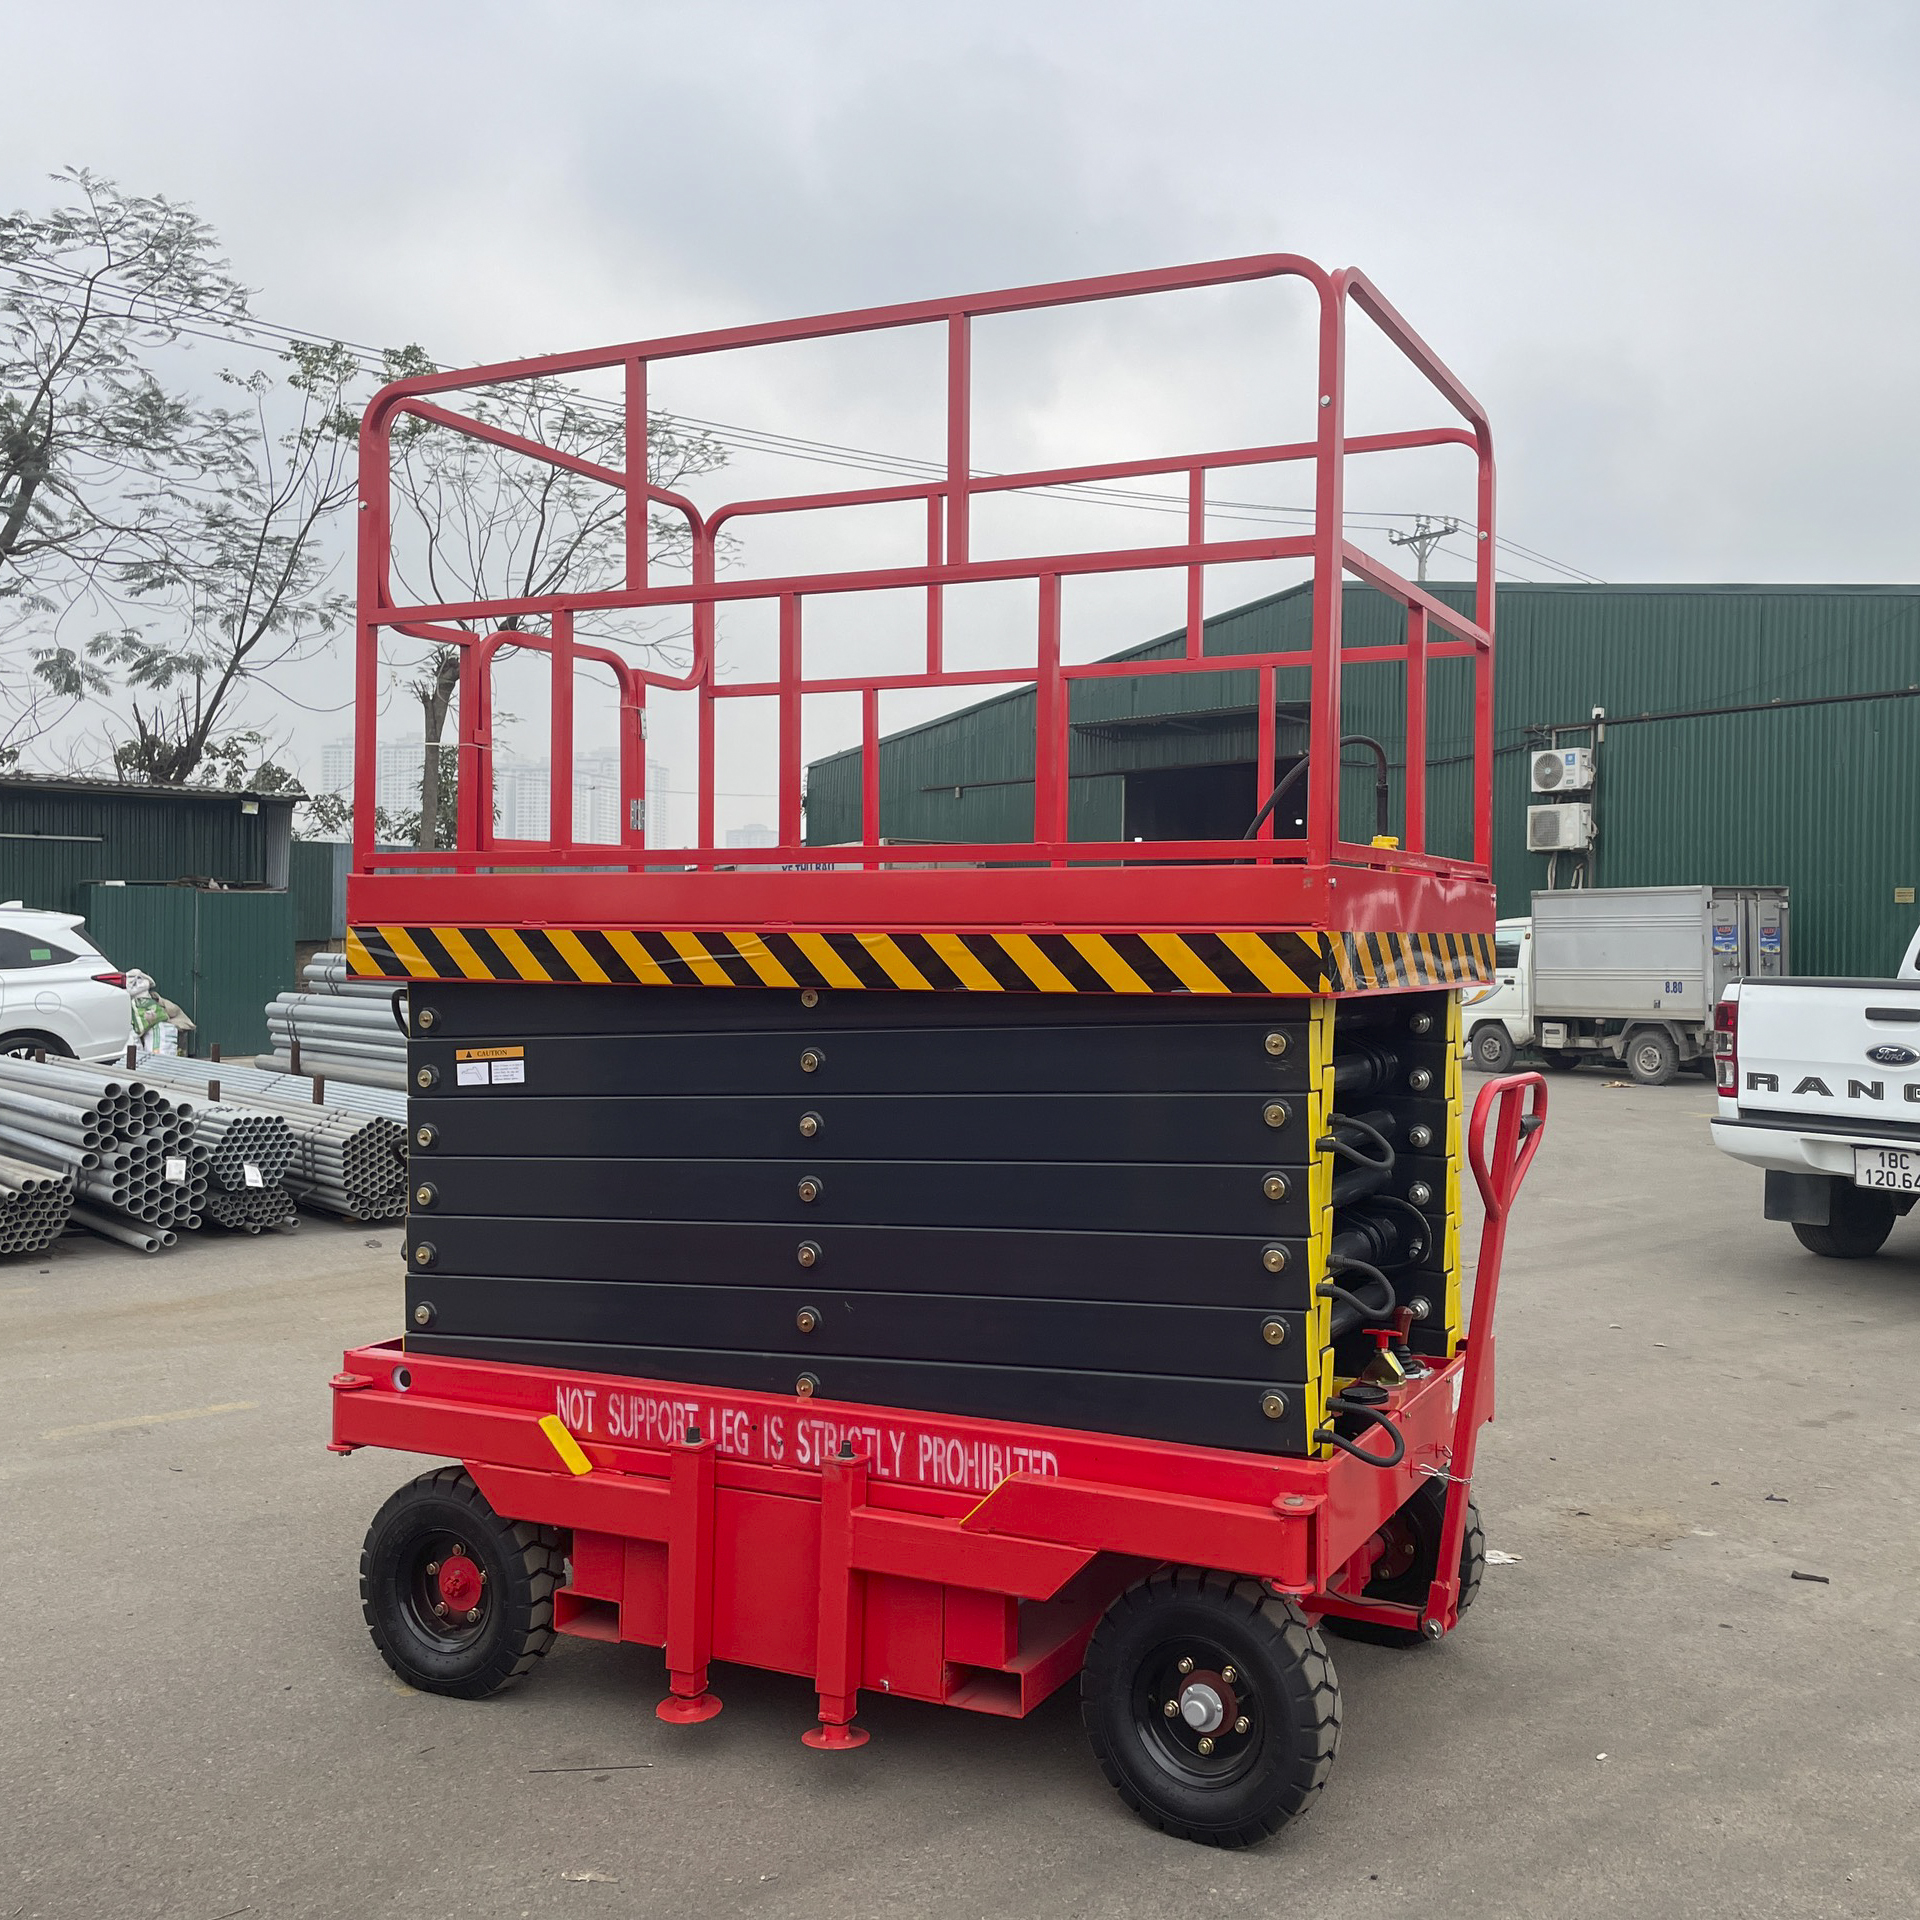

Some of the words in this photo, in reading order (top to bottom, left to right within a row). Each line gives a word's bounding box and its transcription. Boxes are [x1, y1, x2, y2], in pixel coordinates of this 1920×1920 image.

[1665, 981, 1683, 994] 8.80
[1876, 1047, 1906, 1061] Ford
[1879, 1151, 1910, 1170] 18C
[556, 1385, 597, 1434] NOT
[608, 1392, 699, 1444] SUPPORT
[709, 1406, 750, 1457] LEG
[763, 1414, 785, 1461] IS
